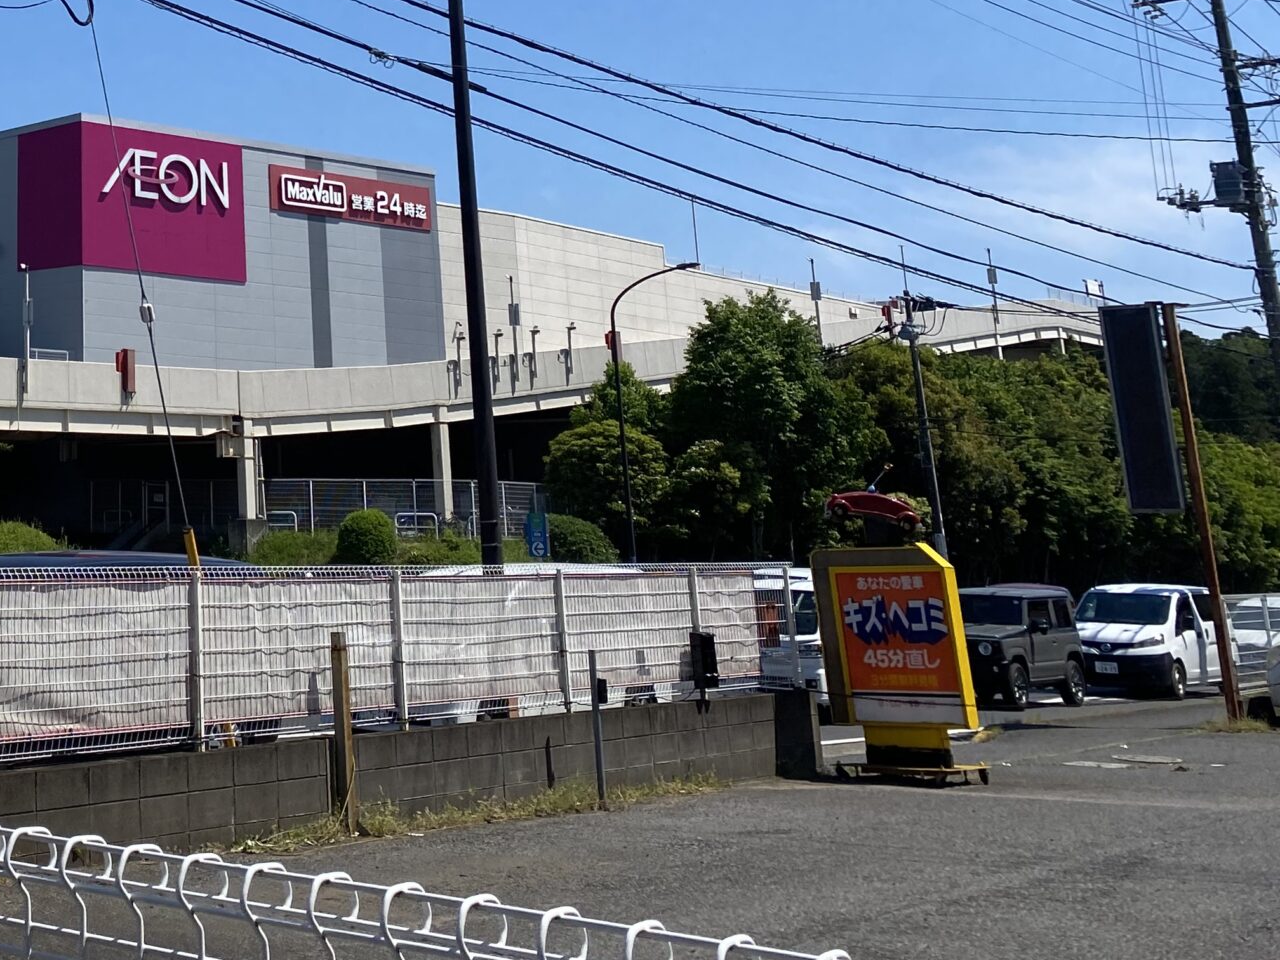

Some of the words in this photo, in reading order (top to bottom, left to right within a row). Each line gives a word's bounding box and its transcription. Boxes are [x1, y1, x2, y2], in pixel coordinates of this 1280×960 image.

[287, 174, 342, 206] MaxValu
[863, 649, 940, 669] 45分直し
